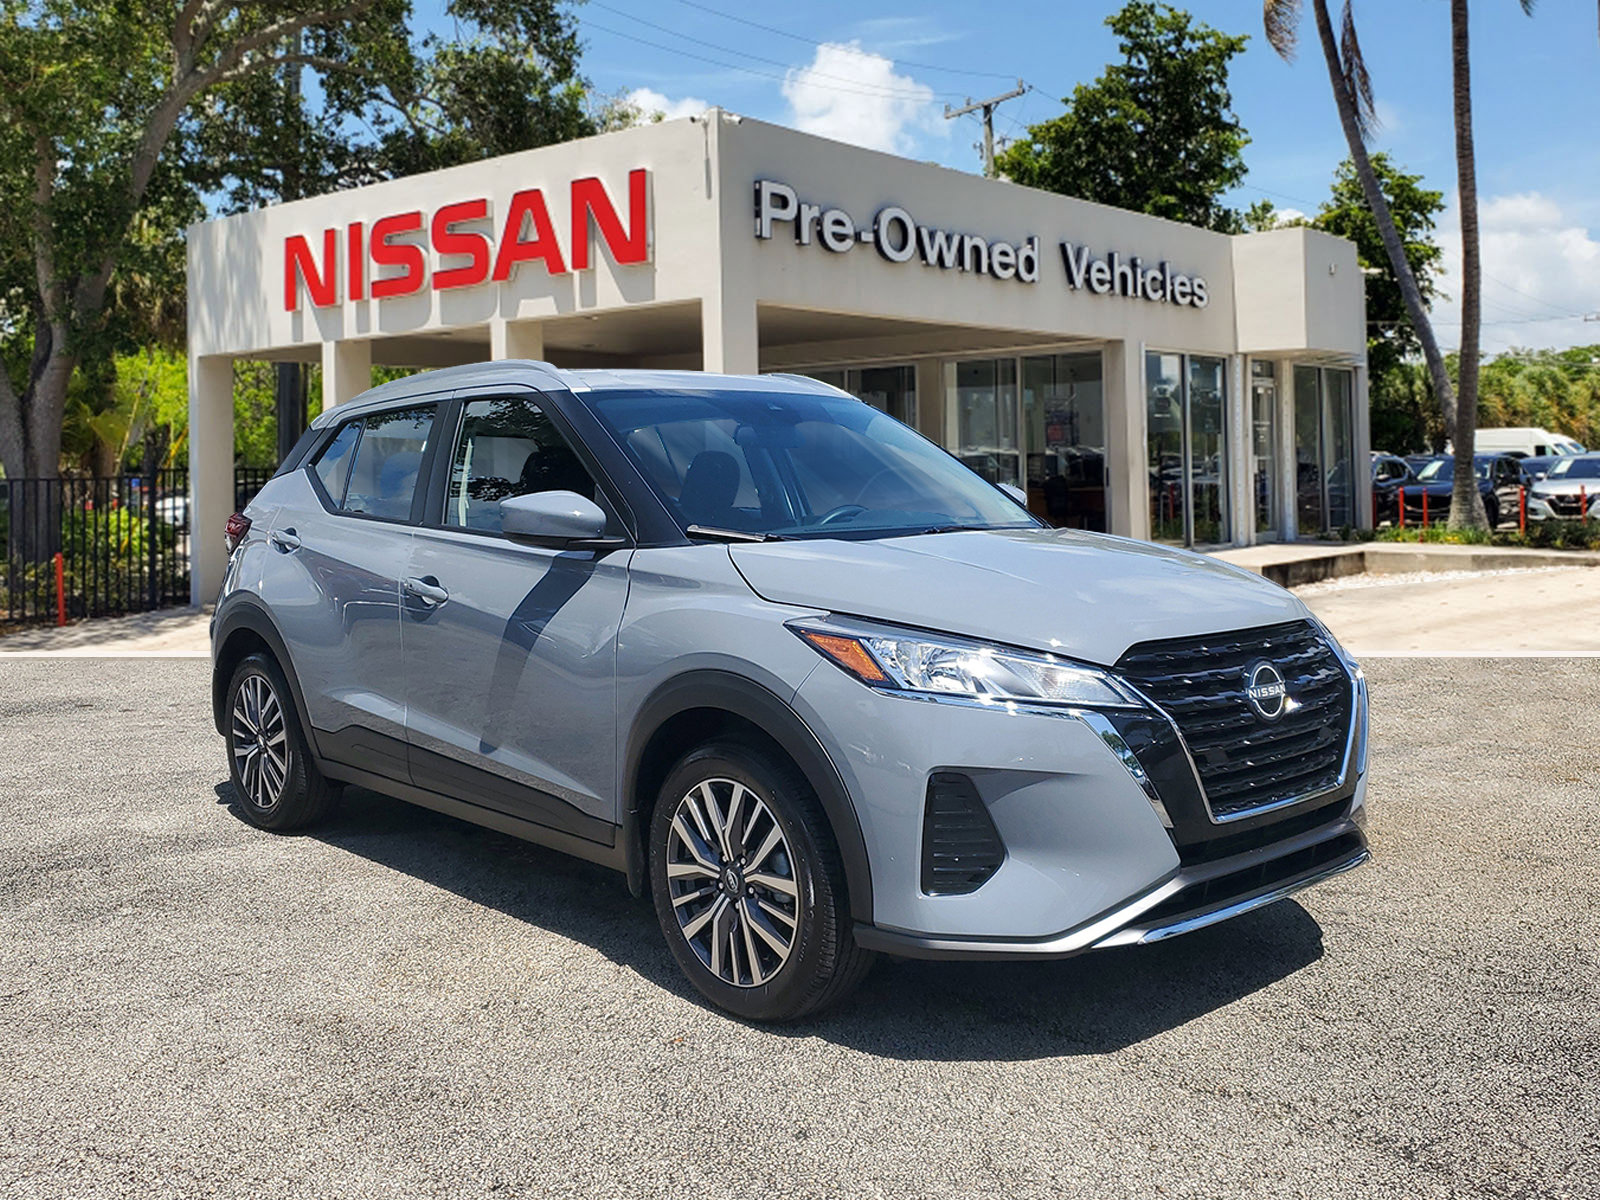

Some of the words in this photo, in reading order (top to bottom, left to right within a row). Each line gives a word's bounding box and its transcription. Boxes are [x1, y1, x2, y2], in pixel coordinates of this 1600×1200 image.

[285, 168, 649, 311] NISSAN
[755, 180, 1040, 283] Pre-Owned
[1061, 242, 1209, 308] Vehicles
[1248, 684, 1286, 699] NISSAN
